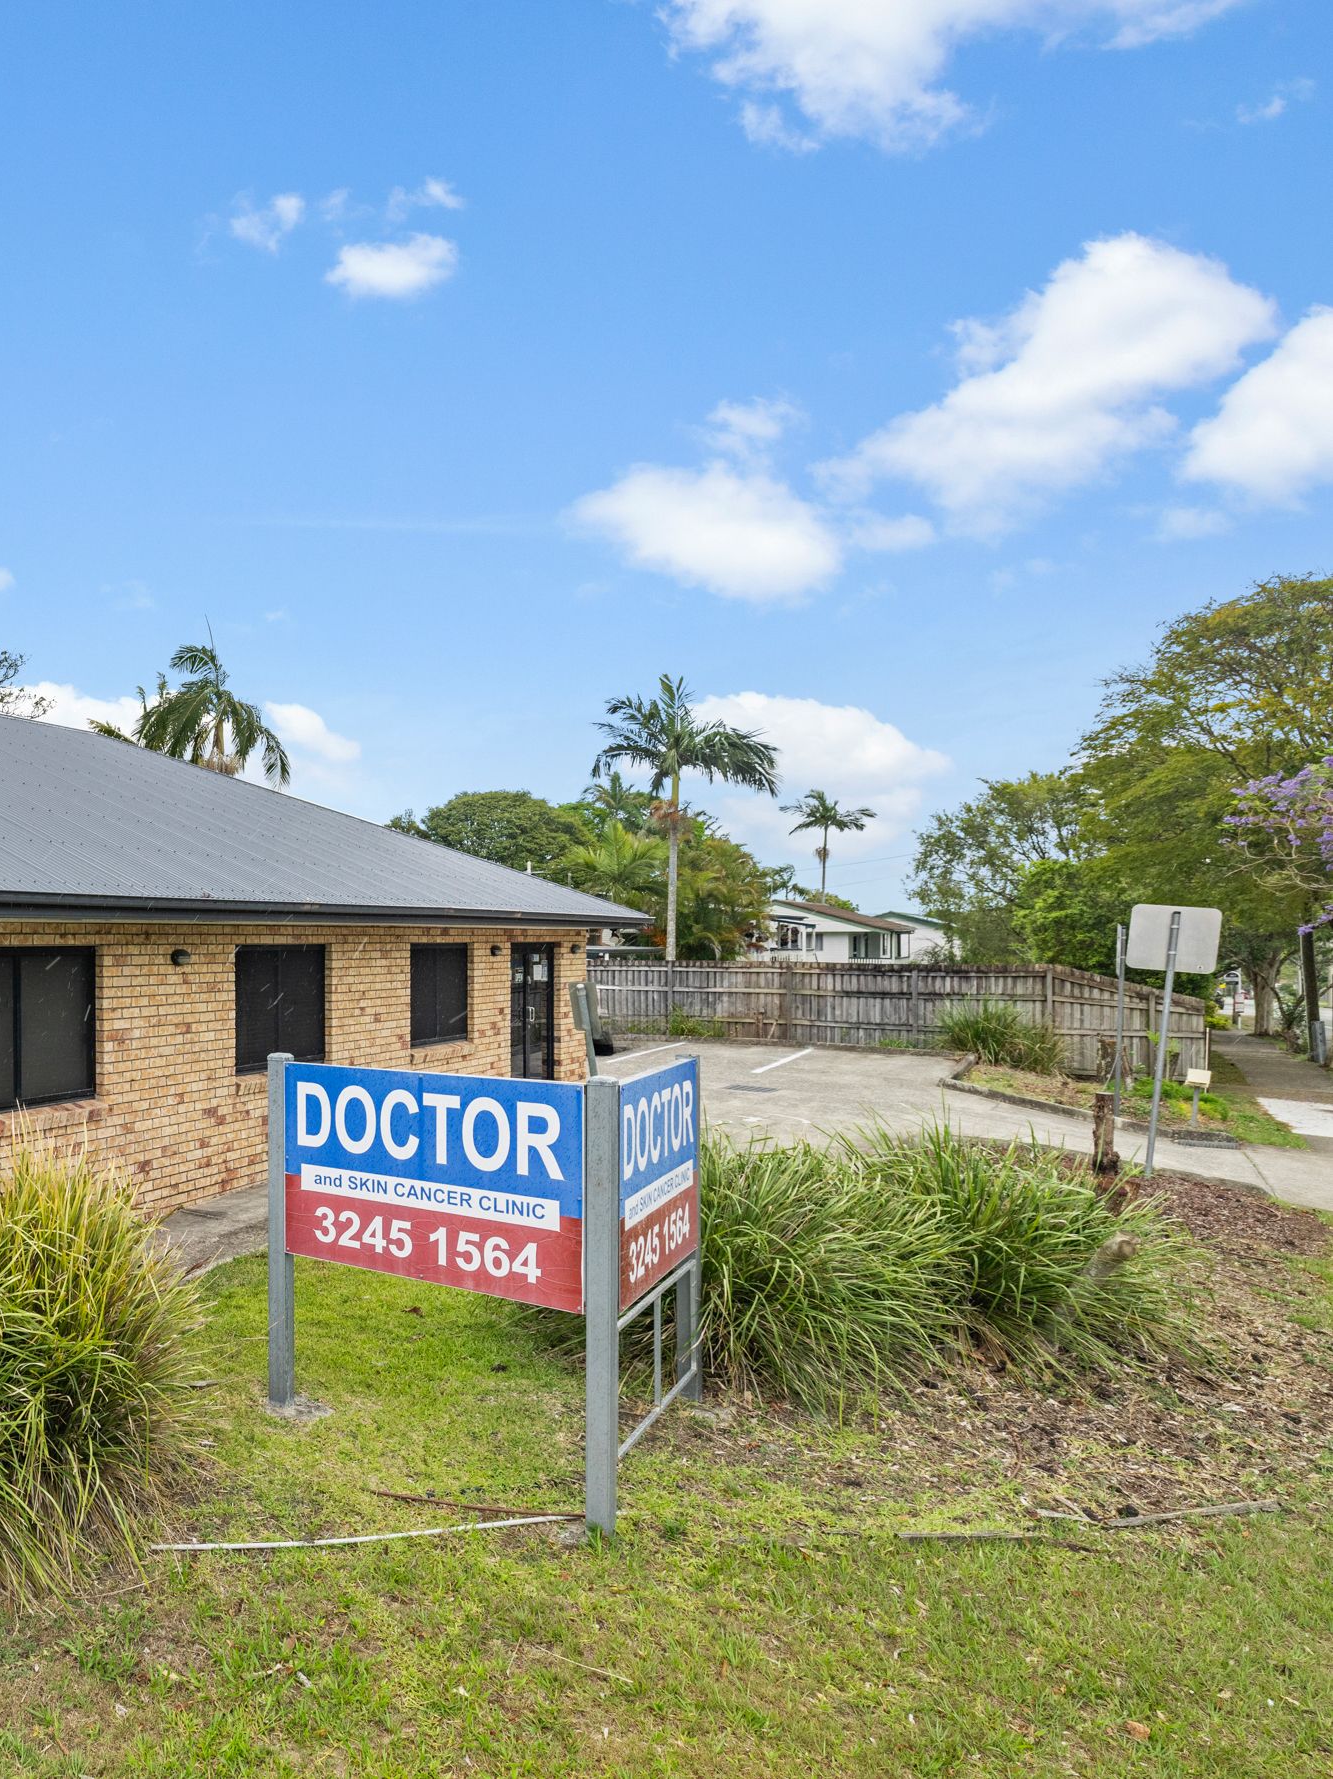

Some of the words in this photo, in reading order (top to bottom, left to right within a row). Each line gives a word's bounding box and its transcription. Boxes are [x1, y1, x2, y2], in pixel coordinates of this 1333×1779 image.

[296, 1081, 565, 1181] DOCTOR
[623, 1079, 694, 1181] DOCTOR
[314, 1174, 342, 1188] and
[348, 1176, 388, 1195] SKIN
[394, 1183, 472, 1208] CANCER
[479, 1196, 546, 1220] CLINIC
[628, 1200, 638, 1220] and
[640, 1190, 652, 1212] SKIN
[653, 1177, 674, 1202] CANCER
[675, 1167, 690, 1188] CLINIC
[314, 1206, 413, 1258] 3245
[429, 1226, 542, 1284] 1564
[629, 1224, 660, 1284] 3245
[663, 1202, 690, 1255] 1564
